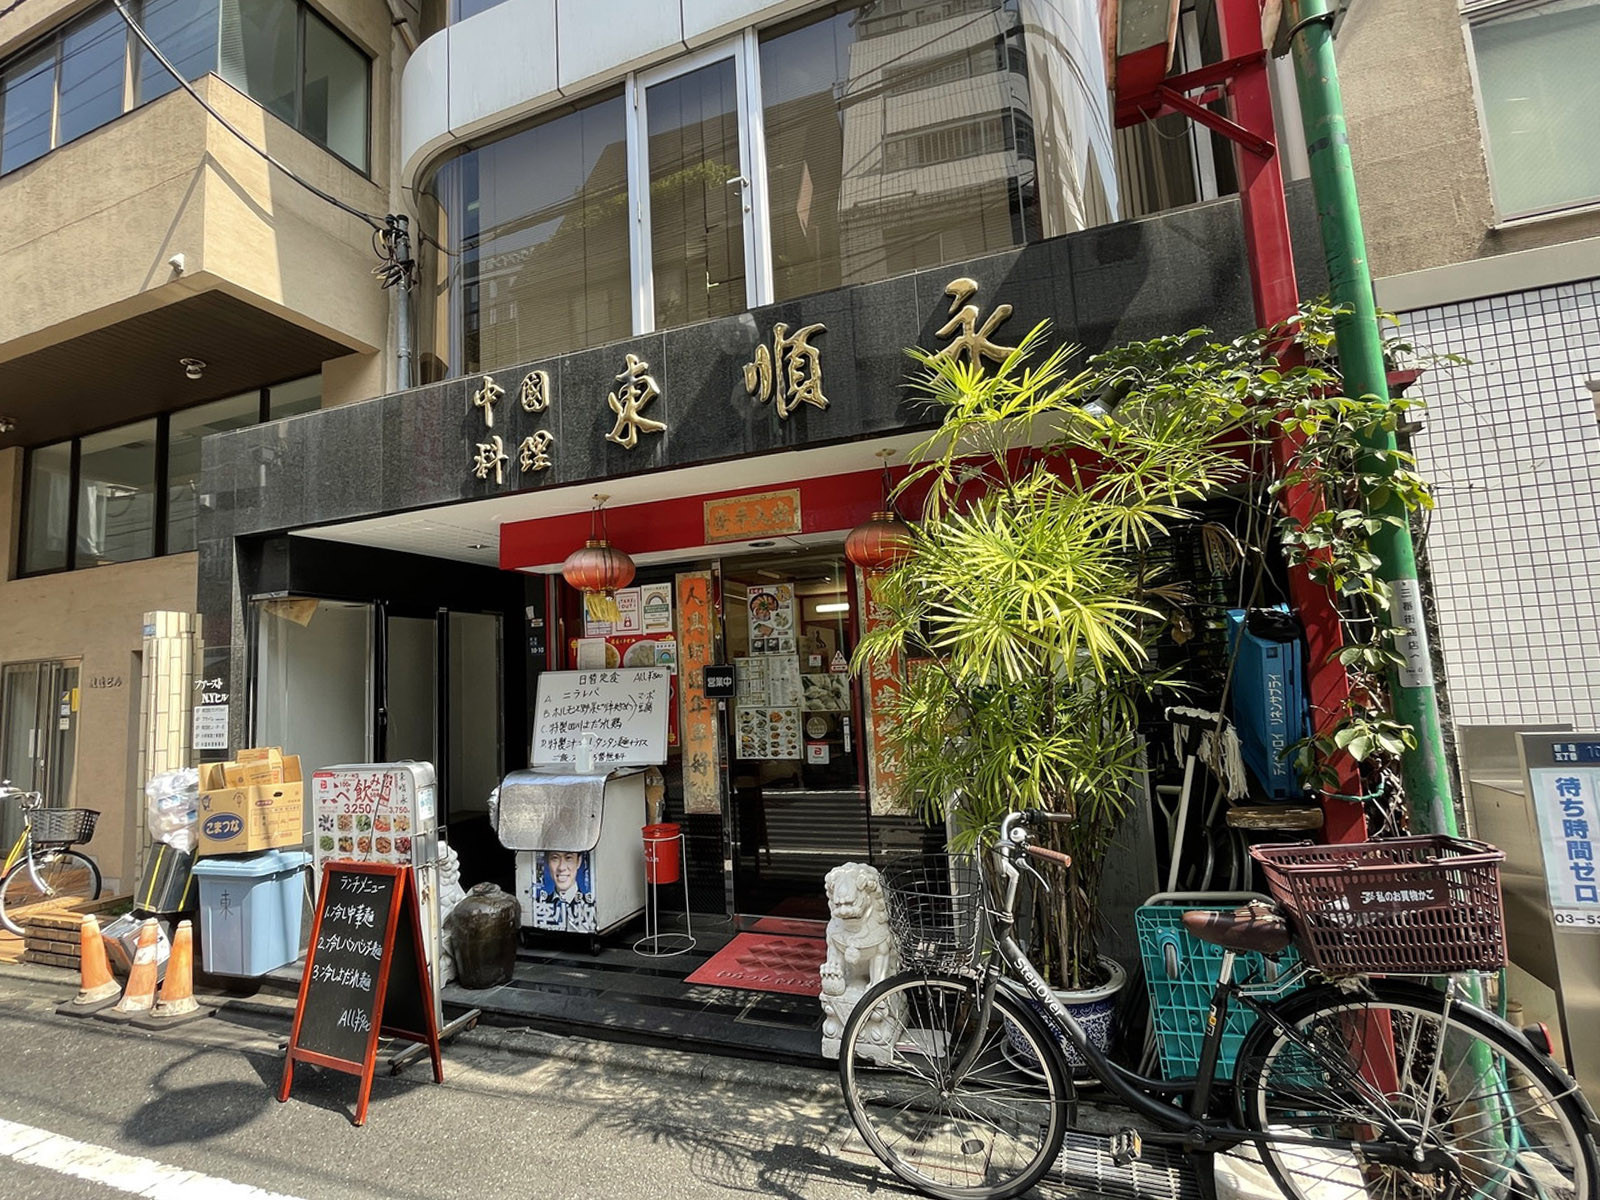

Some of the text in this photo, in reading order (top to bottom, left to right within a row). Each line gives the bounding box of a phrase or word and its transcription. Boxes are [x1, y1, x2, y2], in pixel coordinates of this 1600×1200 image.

[707, 677, 732, 687] 営業中
[206, 819, 241, 834] こまつな
[1554, 777, 1599, 903] 待ち時間ゼロ
[341, 876, 386, 894] ランチメニュー
[219, 889, 234, 921] 東
